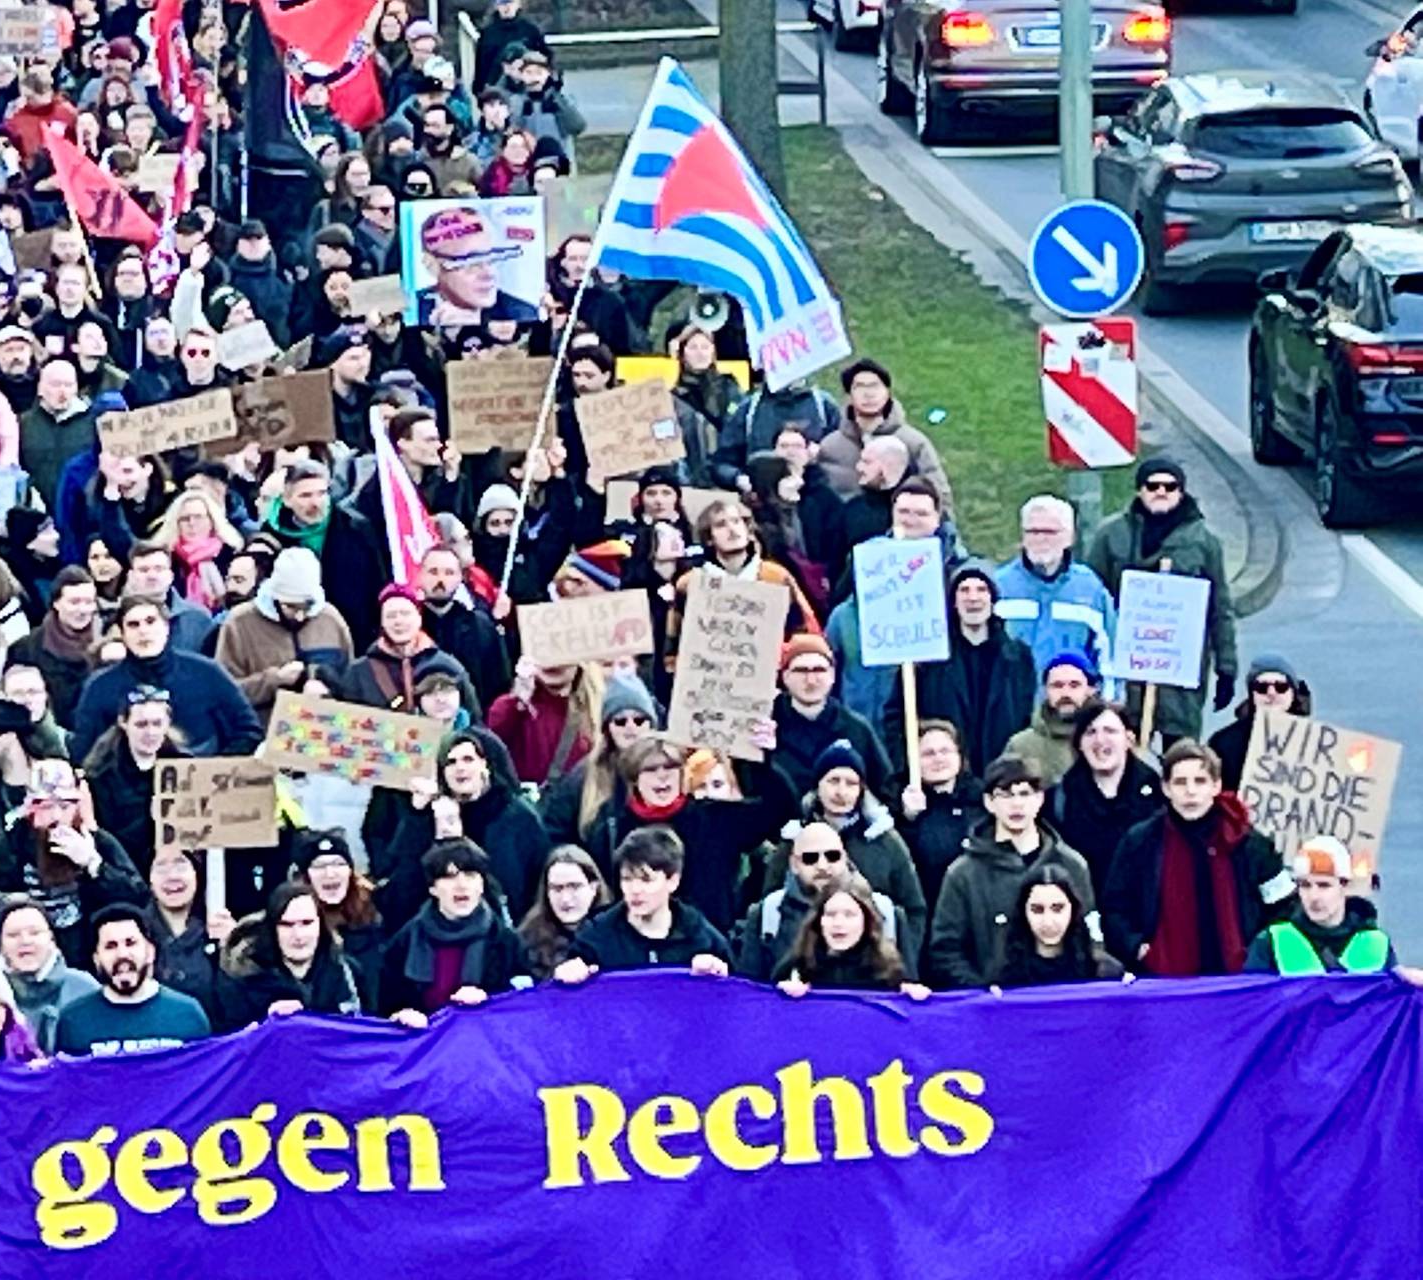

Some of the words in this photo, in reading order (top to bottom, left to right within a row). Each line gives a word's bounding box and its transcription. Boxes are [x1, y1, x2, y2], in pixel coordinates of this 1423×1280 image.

[1264, 711, 1336, 768] WIR
[1252, 753, 1316, 794] SIND
[1320, 770, 1376, 812] DIE
[31, 1103, 446, 1250] gegen
[539, 1059, 995, 1189] Rechts
